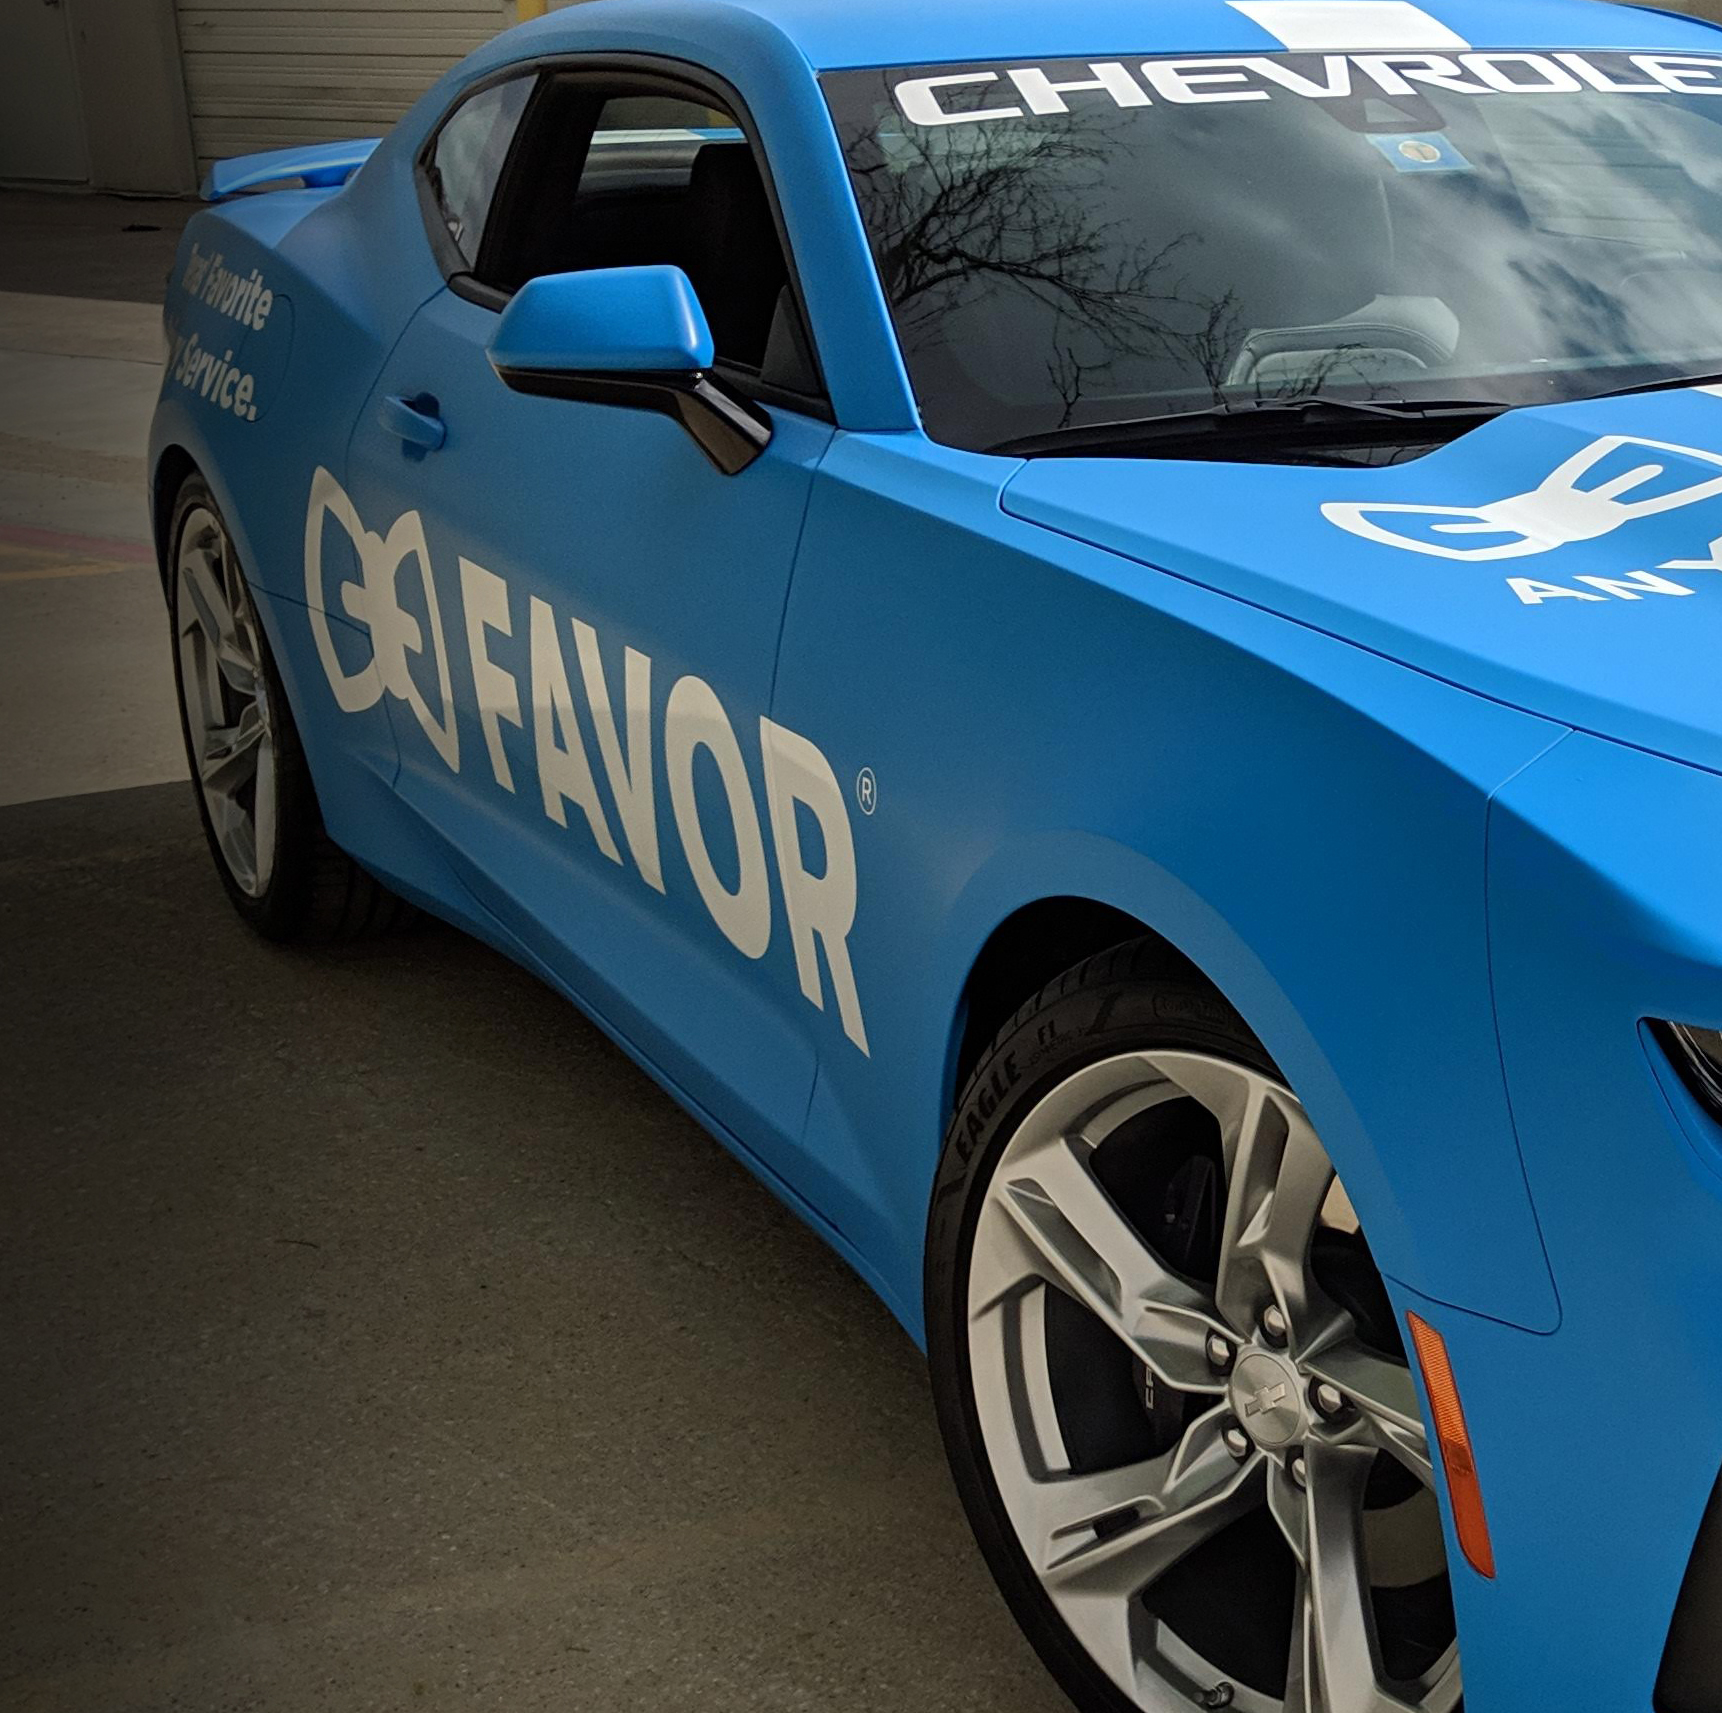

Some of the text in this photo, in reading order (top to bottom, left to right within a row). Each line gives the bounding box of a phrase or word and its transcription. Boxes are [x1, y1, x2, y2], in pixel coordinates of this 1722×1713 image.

[199, 253, 275, 330] Favorite
[459, 556, 871, 1059] FAVOR
[955, 1050, 1022, 1164] EAGLE
